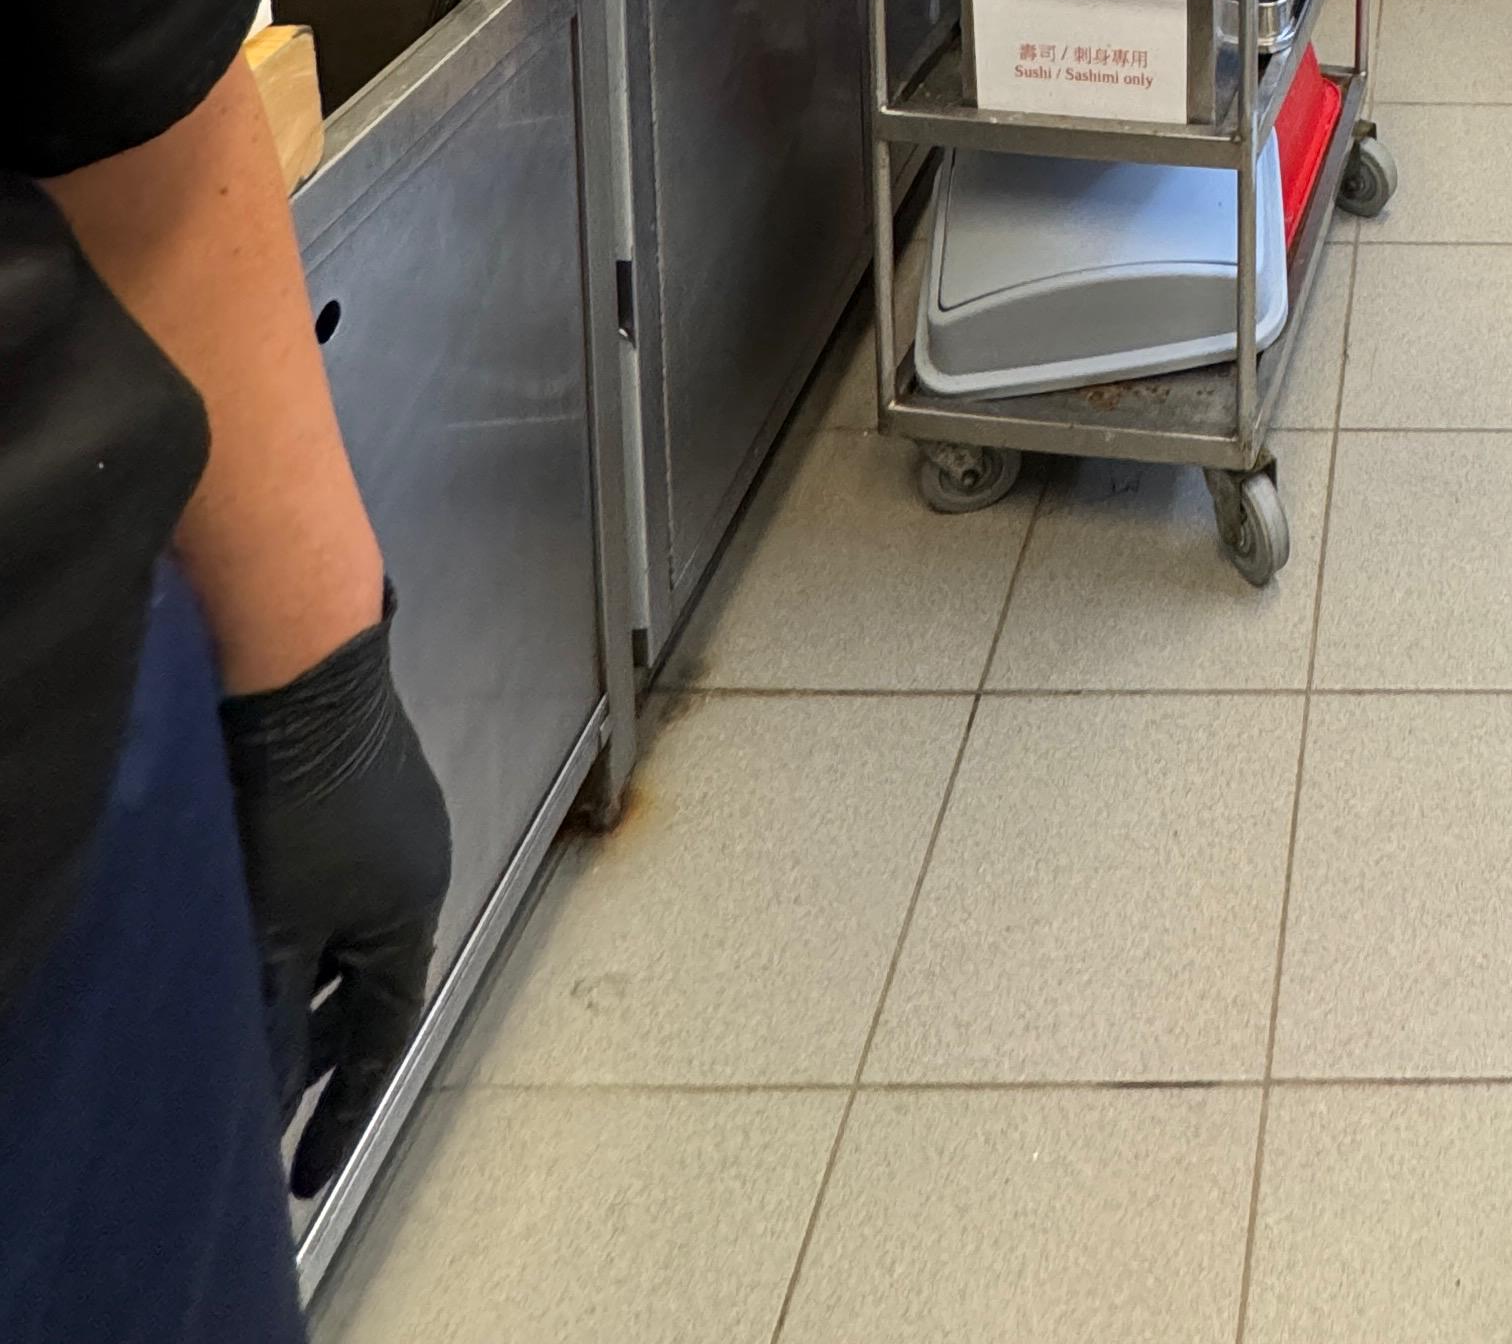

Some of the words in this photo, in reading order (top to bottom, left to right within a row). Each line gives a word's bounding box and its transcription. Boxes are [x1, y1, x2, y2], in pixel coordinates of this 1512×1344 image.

[1020, 43, 1056, 62] 壽司
[1074, 46, 1148, 69] 刺身專用
[1014, 64, 1051, 79] Sushi
[1065, 67, 1119, 84] Sashimi
[1123, 72, 1154, 89] only
